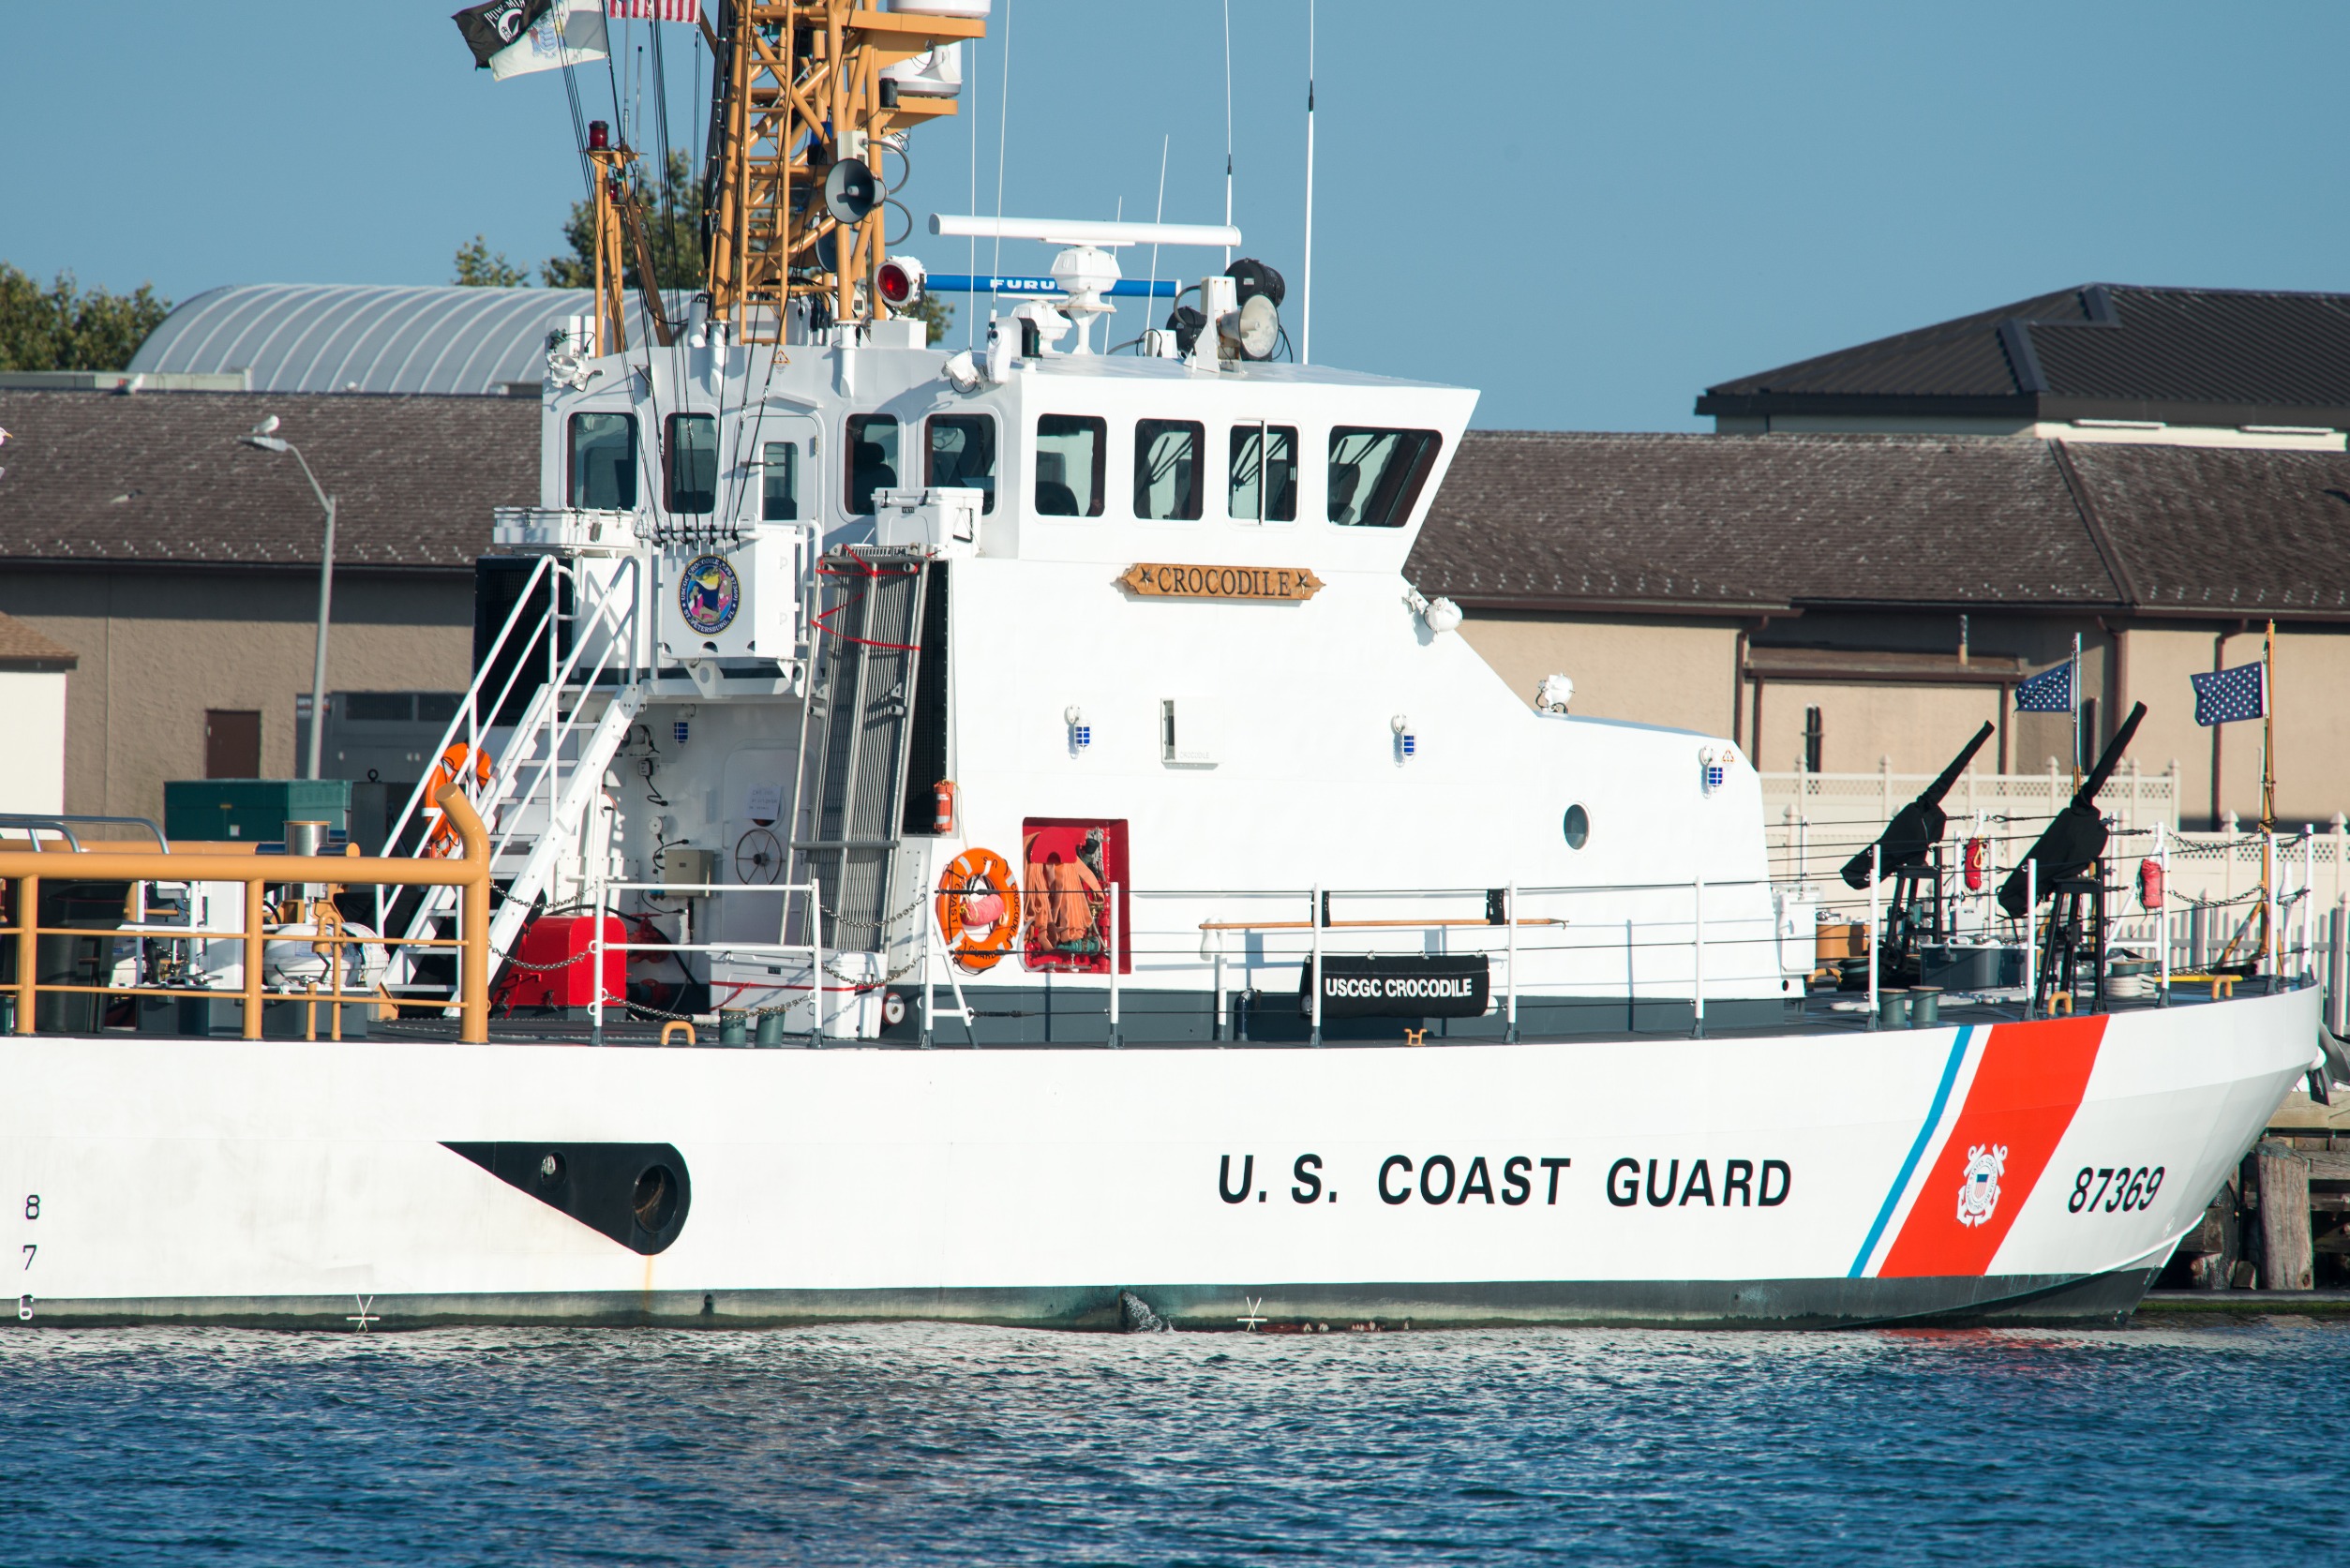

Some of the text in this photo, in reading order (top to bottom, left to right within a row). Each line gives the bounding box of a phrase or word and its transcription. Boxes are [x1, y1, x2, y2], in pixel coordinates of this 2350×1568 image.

[990, 278, 1064, 290] FURU
[1158, 567, 1292, 596] CROCODILE
[1325, 978, 1473, 997] USCGC CROCODILE
[1378, 1154, 1572, 1206] COAST
[1606, 1157, 1792, 1207] GUARD
[2068, 1166, 2165, 1214] 87369
[25, 1194, 40, 1219] 8
[22, 1244, 37, 1271] 7
[19, 1293, 34, 1321] 6
